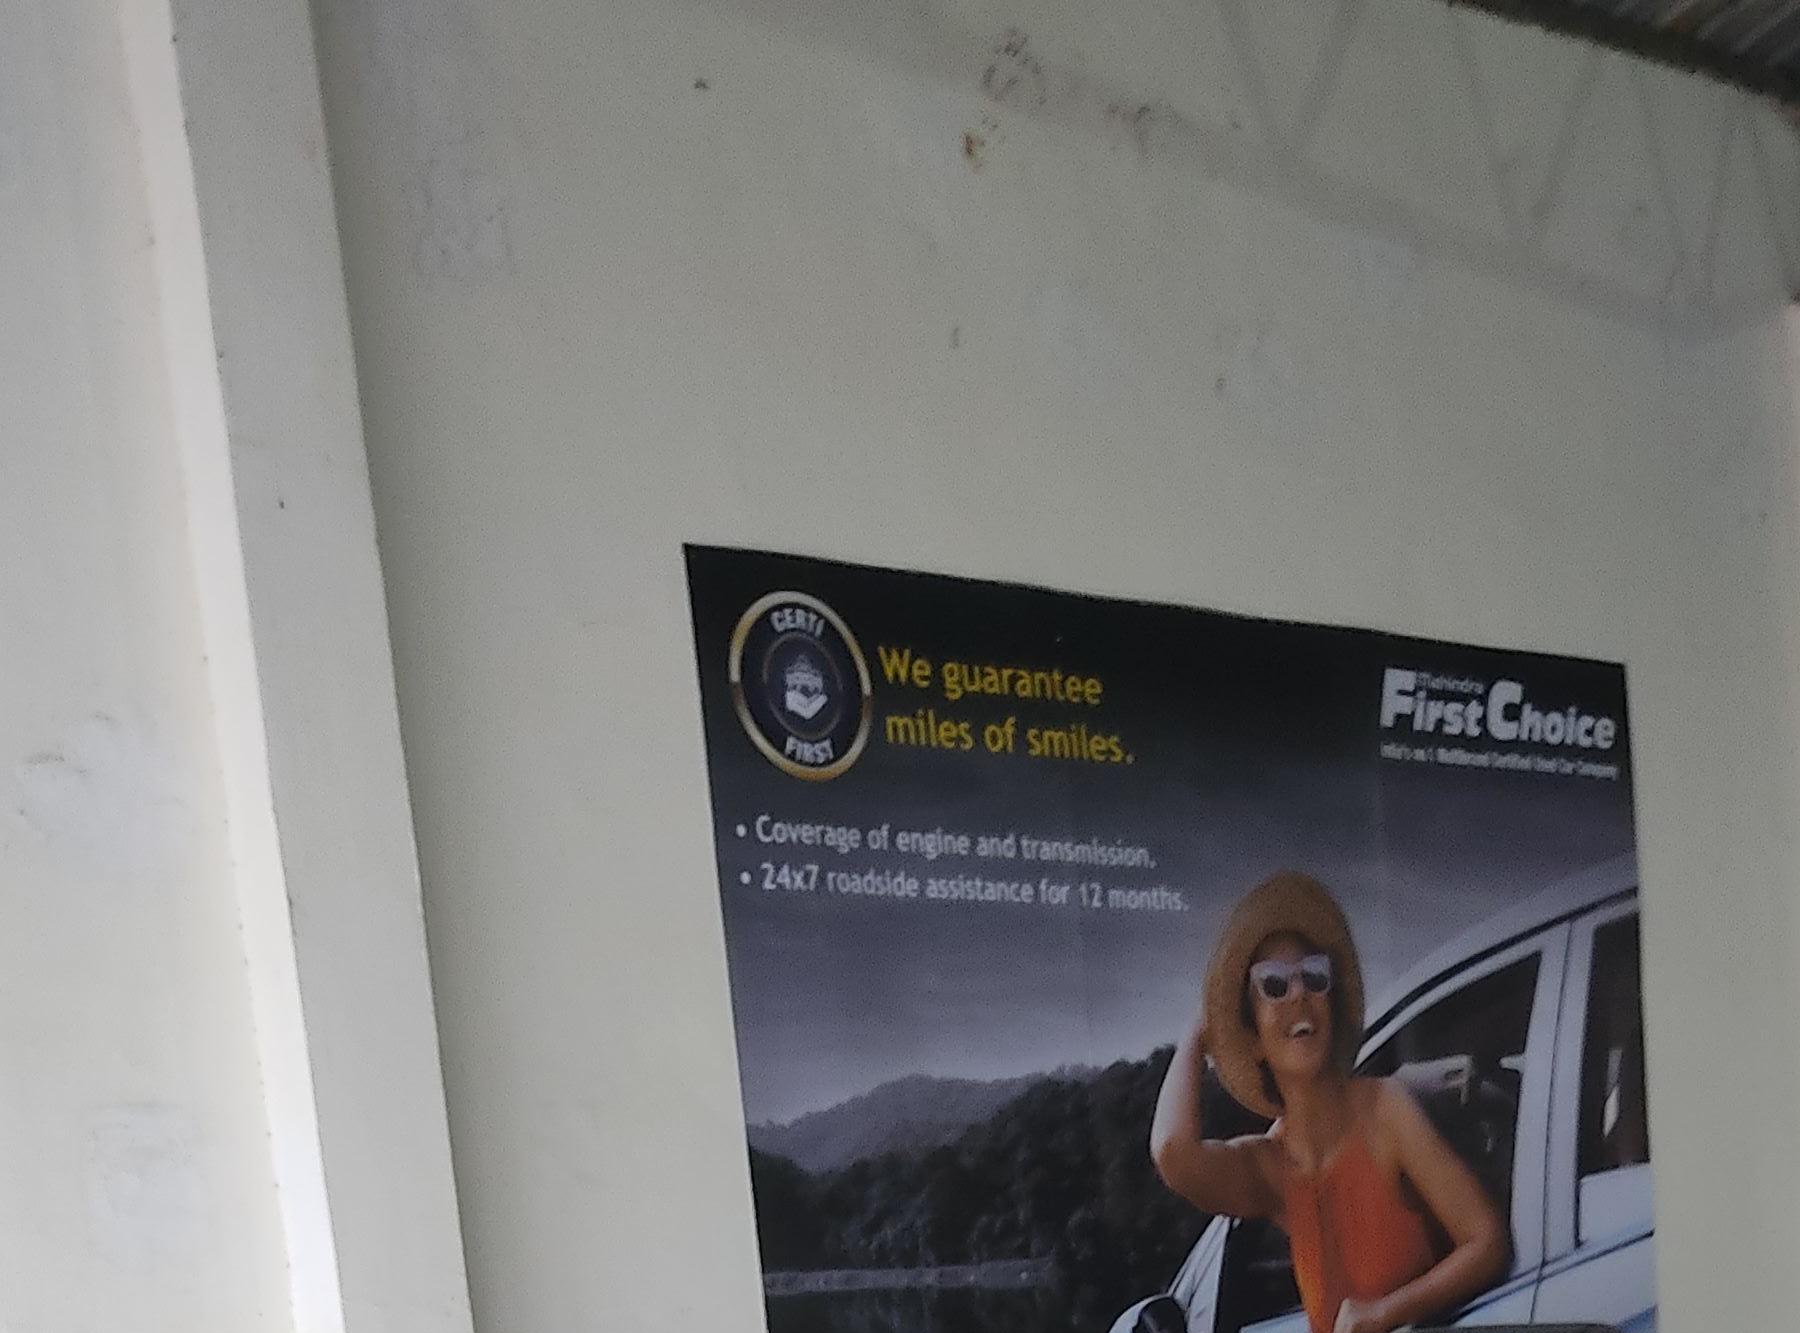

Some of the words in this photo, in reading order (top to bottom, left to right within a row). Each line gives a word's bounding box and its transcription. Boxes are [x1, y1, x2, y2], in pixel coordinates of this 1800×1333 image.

[770, 607, 826, 638] CERTI
[878, 645, 932, 688] We
[942, 660, 1104, 705] guarantee
[1380, 667, 1486, 738] First
[1486, 679, 1617, 750] Choice
[885, 709, 975, 751] miles
[983, 716, 1017, 753] of
[1026, 723, 1136, 765] smiles.
[755, 814, 862, 855] Coverage
[867, 823, 891, 850] of
[896, 827, 971, 861] engine
[977, 833, 1016, 858] and
[1020, 834, 1158, 869] transmission.
[760, 862, 820, 891] 24x7
[826, 867, 920, 898] roadside
[925, 874, 1035, 903] assistance
[1037, 877, 1070, 905] for
[1079, 882, 1104, 908] 12
[1108, 885, 1189, 911] months.
